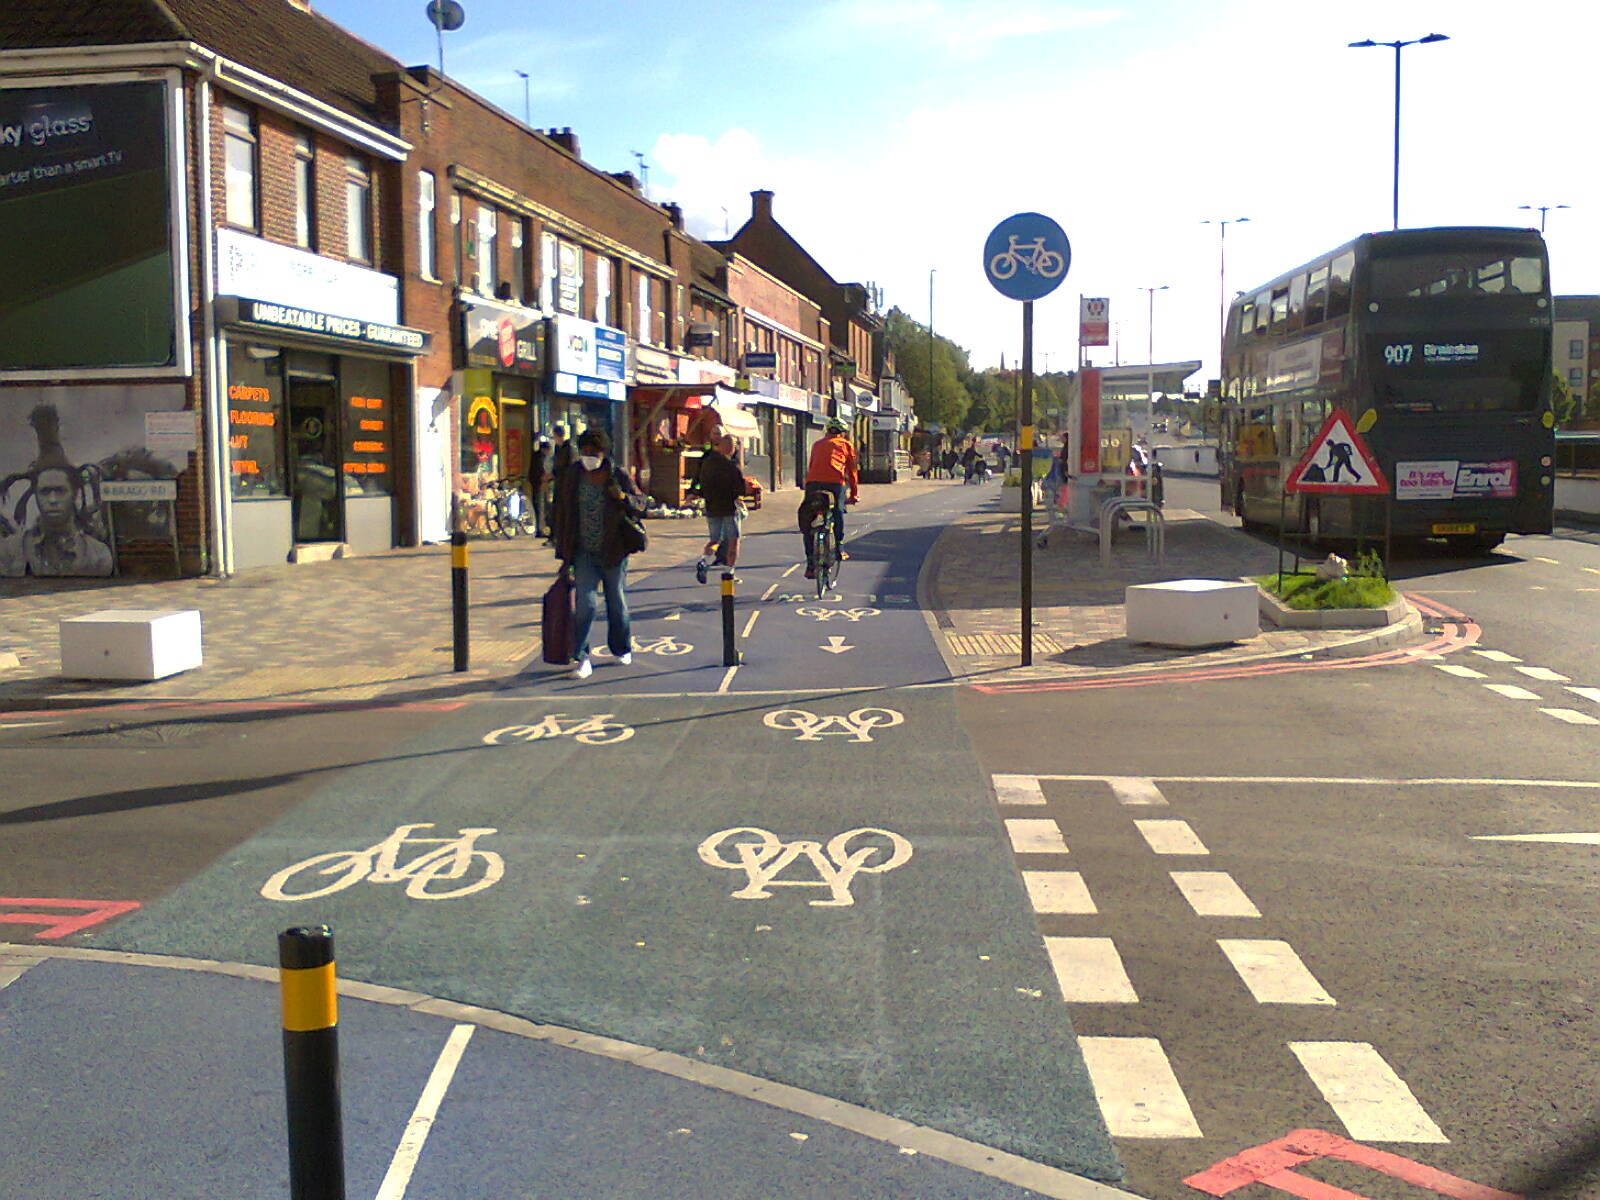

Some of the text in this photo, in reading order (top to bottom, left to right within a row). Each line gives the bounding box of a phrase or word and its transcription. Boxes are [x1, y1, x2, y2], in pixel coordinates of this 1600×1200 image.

[30, 115, 91, 145] glass
[252, 302, 325, 331] UNBEATABLE
[325, 315, 360, 338] PRICES
[1384, 344, 1413, 364] 907
[228, 385, 270, 402] CARPETS
[229, 409, 275, 426] FLOORING
